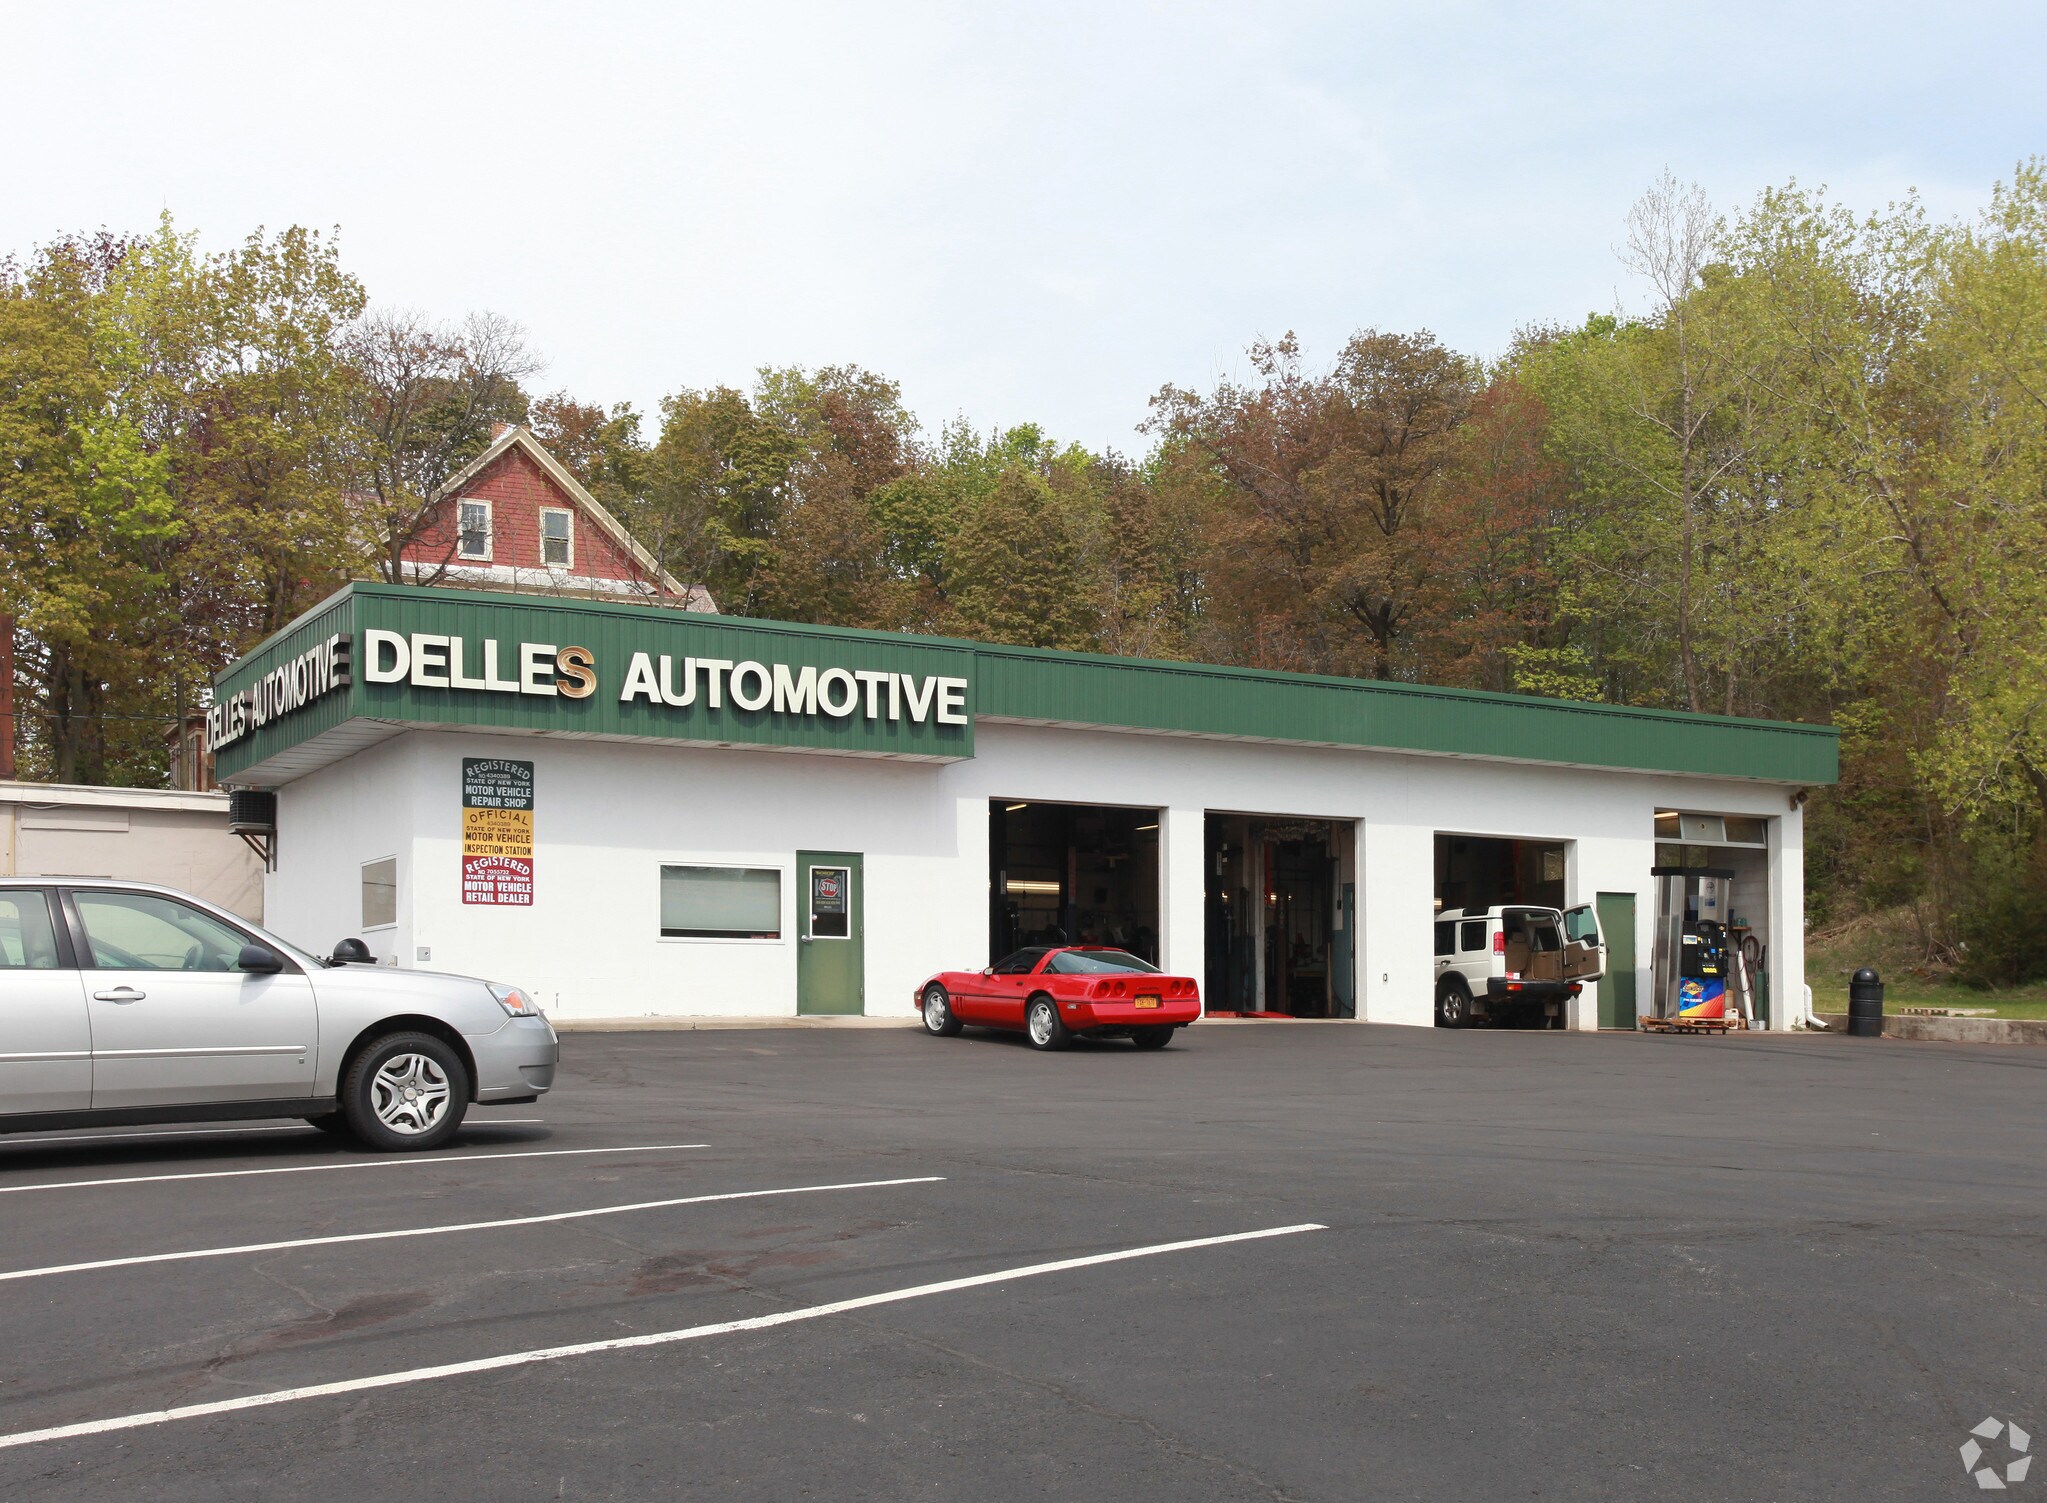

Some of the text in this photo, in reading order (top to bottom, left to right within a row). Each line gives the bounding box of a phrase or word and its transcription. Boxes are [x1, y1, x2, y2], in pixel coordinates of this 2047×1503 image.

[365, 629, 968, 725] DELLES AUTOMOTIVE
[206, 633, 342, 753] DELLES AUTOMOTIVE
[466, 761, 530, 779] REGISTERED
[466, 785, 531, 797] MOTOR VEHICLE
[472, 796, 527, 807] REPAIR SHOP
[470, 810, 528, 826] OFFICIAL
[466, 832, 531, 843] MOTOR VEHICLE
[465, 844, 531, 855] INSPECTION STATION
[466, 857, 530, 875] REGISTERED
[464, 881, 532, 892] MOTOR VEHICLE
[821, 881, 837, 892] STOP
[466, 892, 530, 903] RETAIL DEALER
